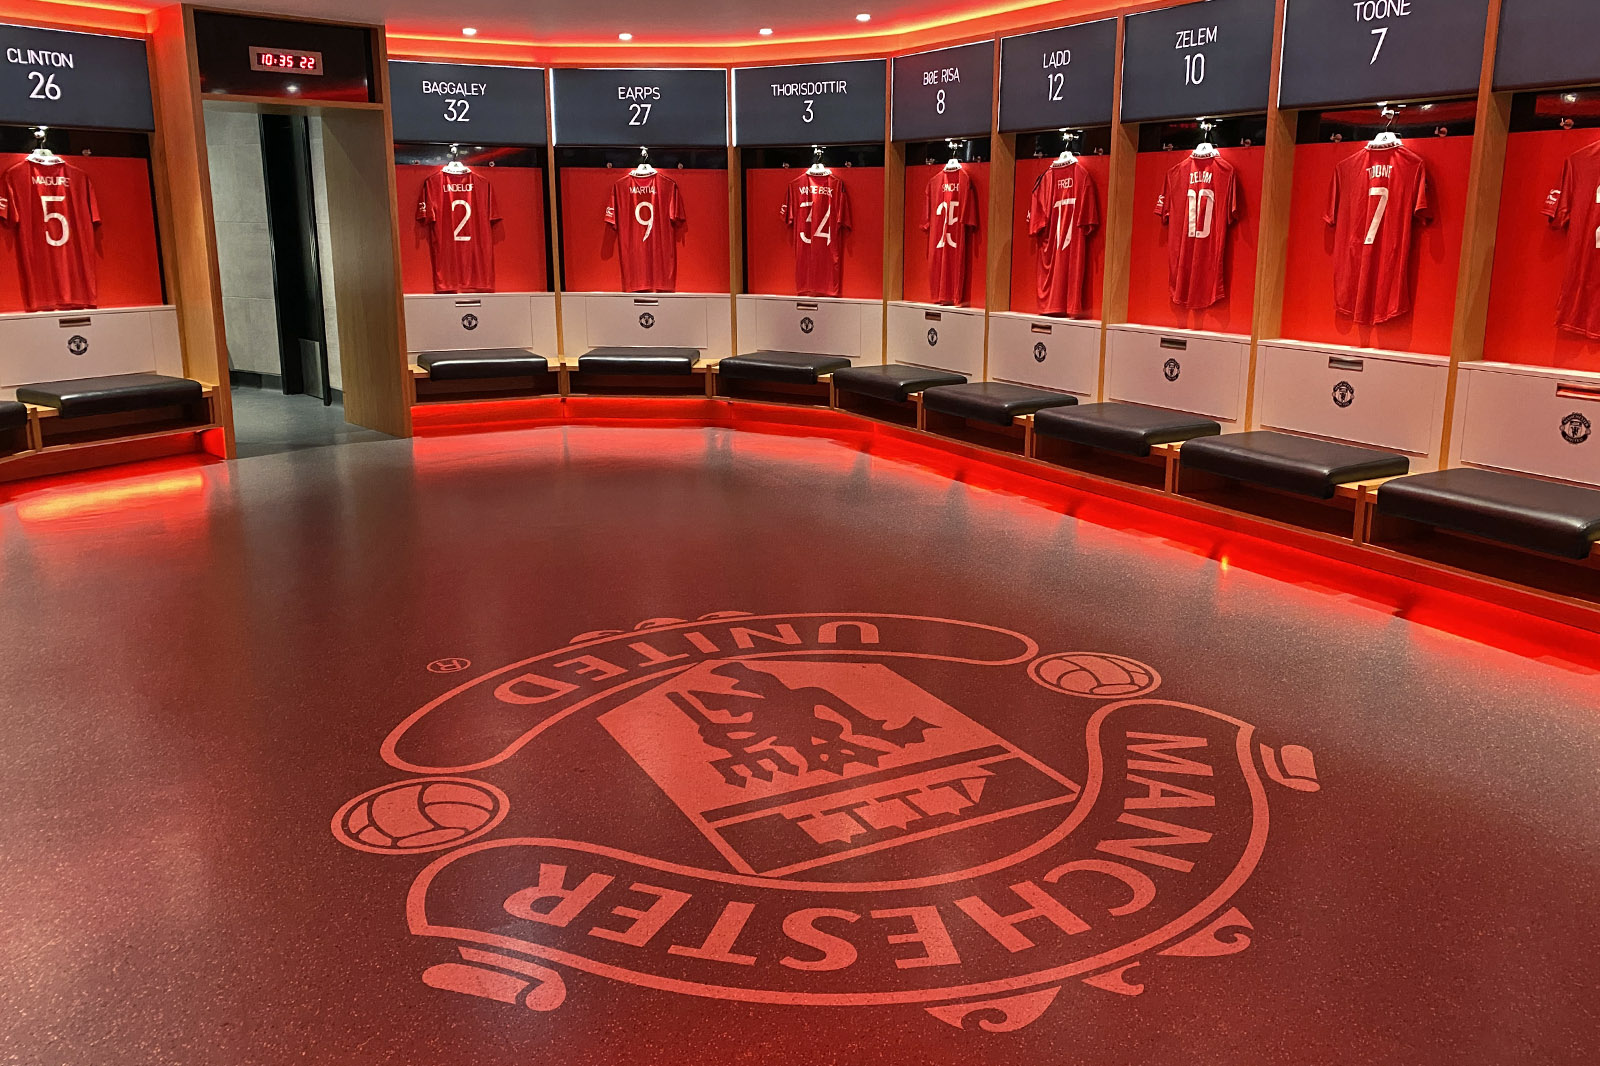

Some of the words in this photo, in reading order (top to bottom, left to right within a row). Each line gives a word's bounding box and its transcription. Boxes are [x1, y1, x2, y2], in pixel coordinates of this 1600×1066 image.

[1353, 0, 1411, 22] TOONE
[1175, 25, 1218, 50] ZELEM
[1369, 27, 1389, 65] 7
[6, 47, 74, 69] CLINTON
[262, 53, 294, 69] 10:35
[299, 55, 316, 71] 22
[1043, 49, 1071, 69] LADD
[1184, 52, 1205, 86] 10
[28, 71, 62, 100] 26
[422, 80, 487, 97] BAGGALEY
[770, 80, 848, 97] THORISDOTTIR
[940, 67, 961, 84] RISA
[1047, 72, 1065, 101] 12
[618, 86, 661, 102] EARPS
[936, 89, 947, 115] 8
[443, 98, 470, 122] 32
[628, 103, 652, 126] 27
[802, 99, 814, 123] 3
[40, 195, 69, 247] 5
[451, 199, 472, 242] 2
[634, 201, 655, 242] 9
[799, 200, 832, 247] 34
[936, 200, 960, 249] 25
[1053, 197, 1077, 251] 17
[1187, 188, 1215, 239] 10
[1363, 186, 1389, 245] 7
[494, 620, 880, 705] UNITED
[504, 731, 1216, 972] MANCHESTER
